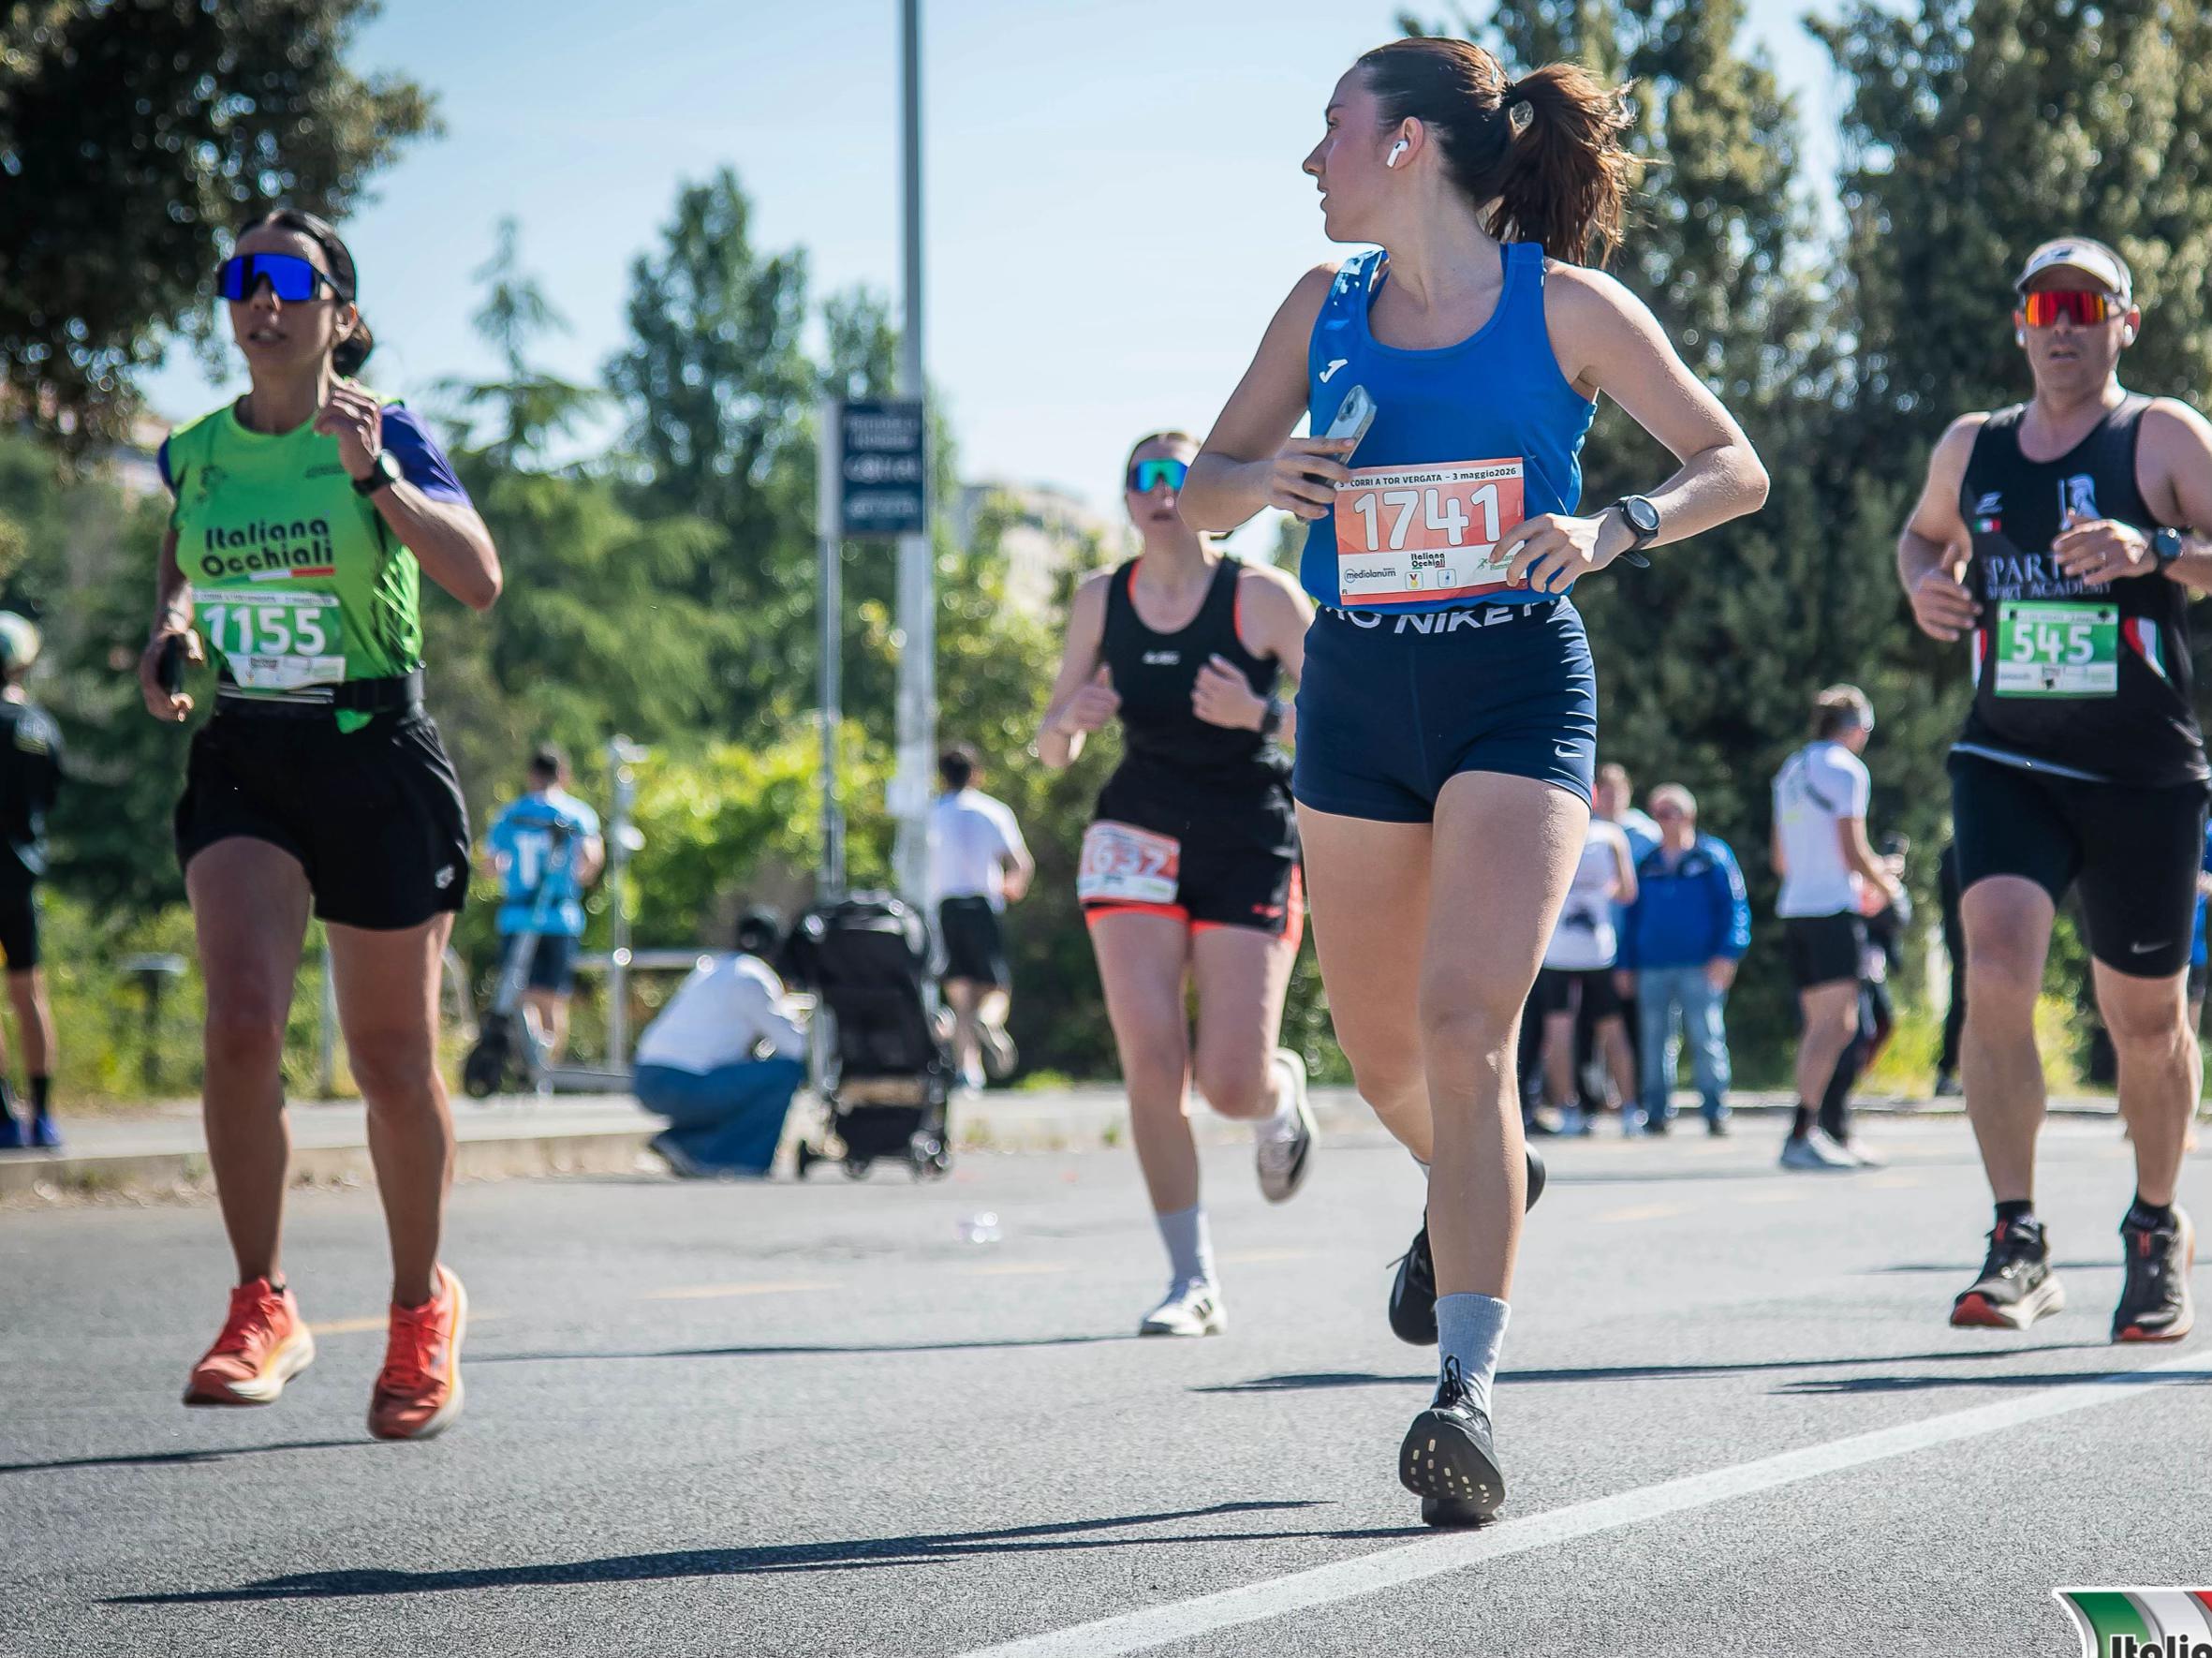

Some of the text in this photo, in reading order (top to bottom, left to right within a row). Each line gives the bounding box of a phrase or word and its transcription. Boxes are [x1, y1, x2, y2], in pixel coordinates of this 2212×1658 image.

[1350, 479, 1373, 487] CORRI
[1383, 477, 1400, 485] TOR
[1402, 474, 1442, 483] VERGATA
[1453, 472, 1458, 481] 3
[1353, 483, 1501, 552] 1741
[205, 518, 328, 552] Italiana
[200, 539, 333, 577] Occhiali
[1347, 570, 1396, 580] mediolanum
[1411, 559, 1446, 568] Occhiali
[202, 607, 326, 656] 1155
[1394, 606, 1513, 634] NIKE
[2013, 623, 2094, 665] 545
